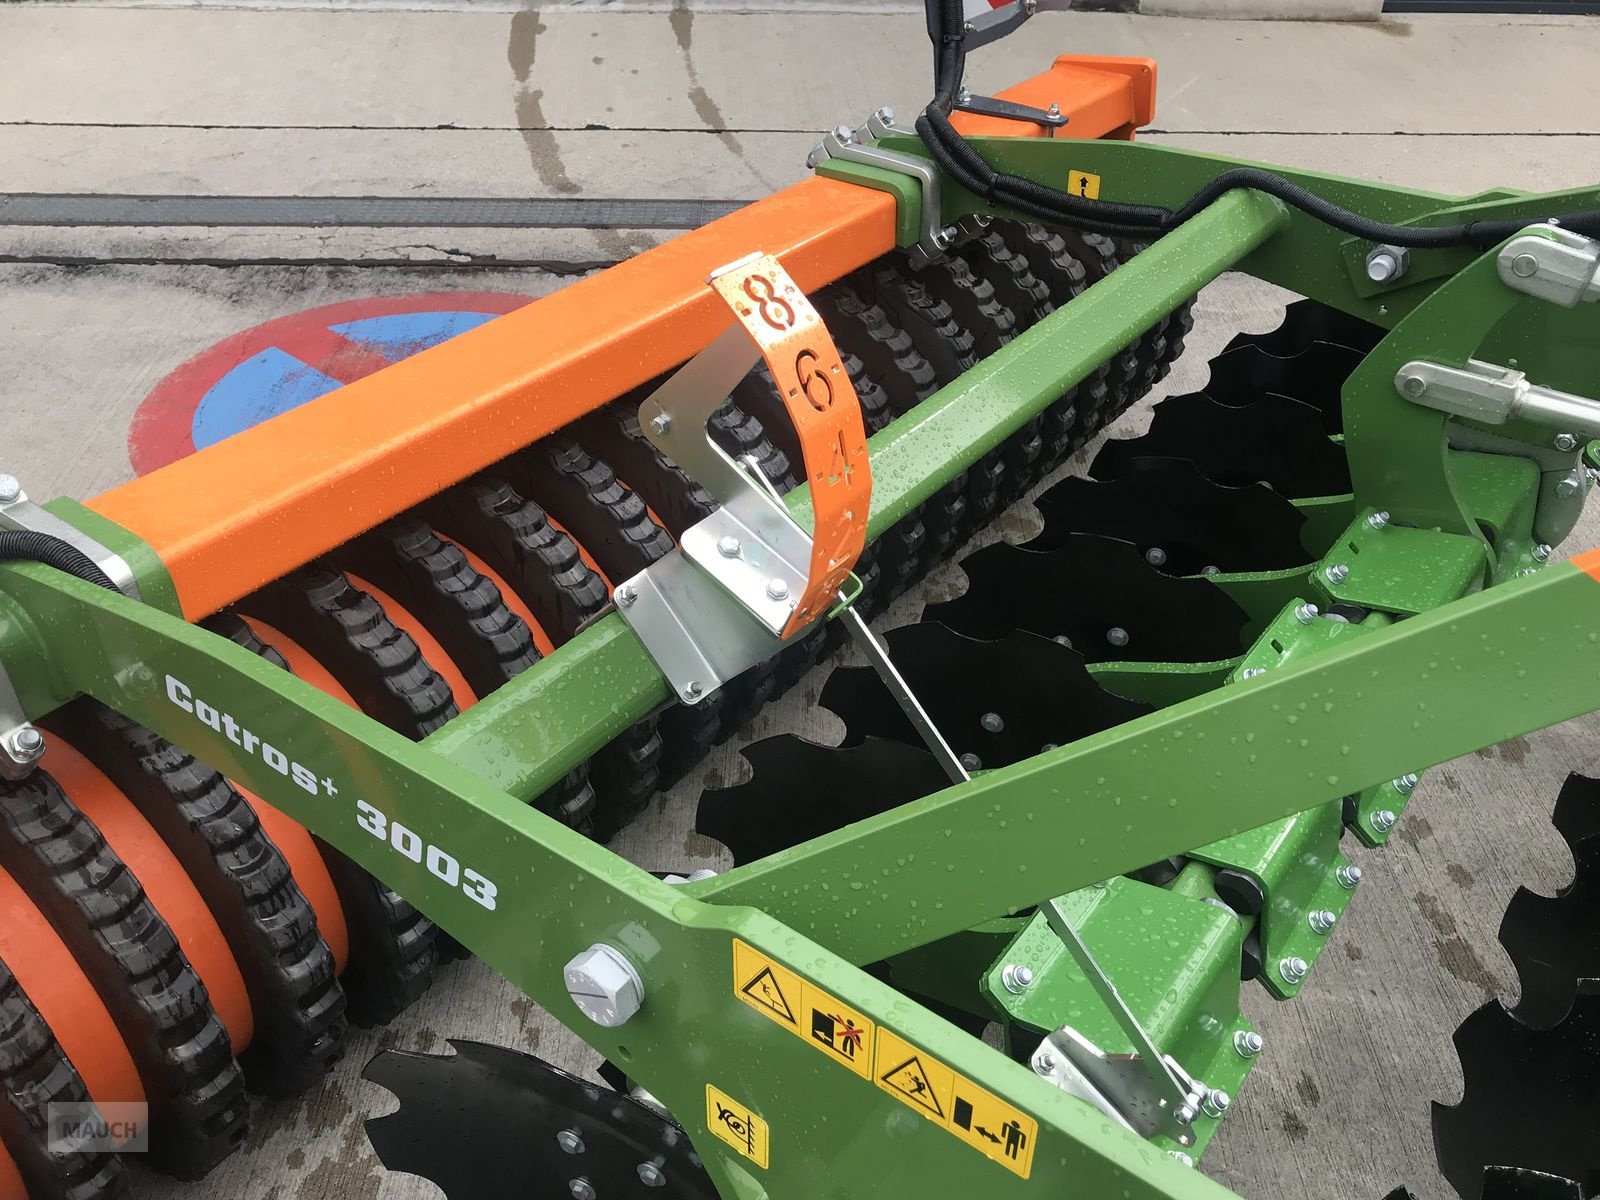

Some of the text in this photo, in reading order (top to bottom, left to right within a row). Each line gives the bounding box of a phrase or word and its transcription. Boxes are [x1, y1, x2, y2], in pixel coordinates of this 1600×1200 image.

[743, 274, 796, 332] 8
[795, 347, 835, 413] 6
[165, 673, 499, 912] Catros+ 3003
